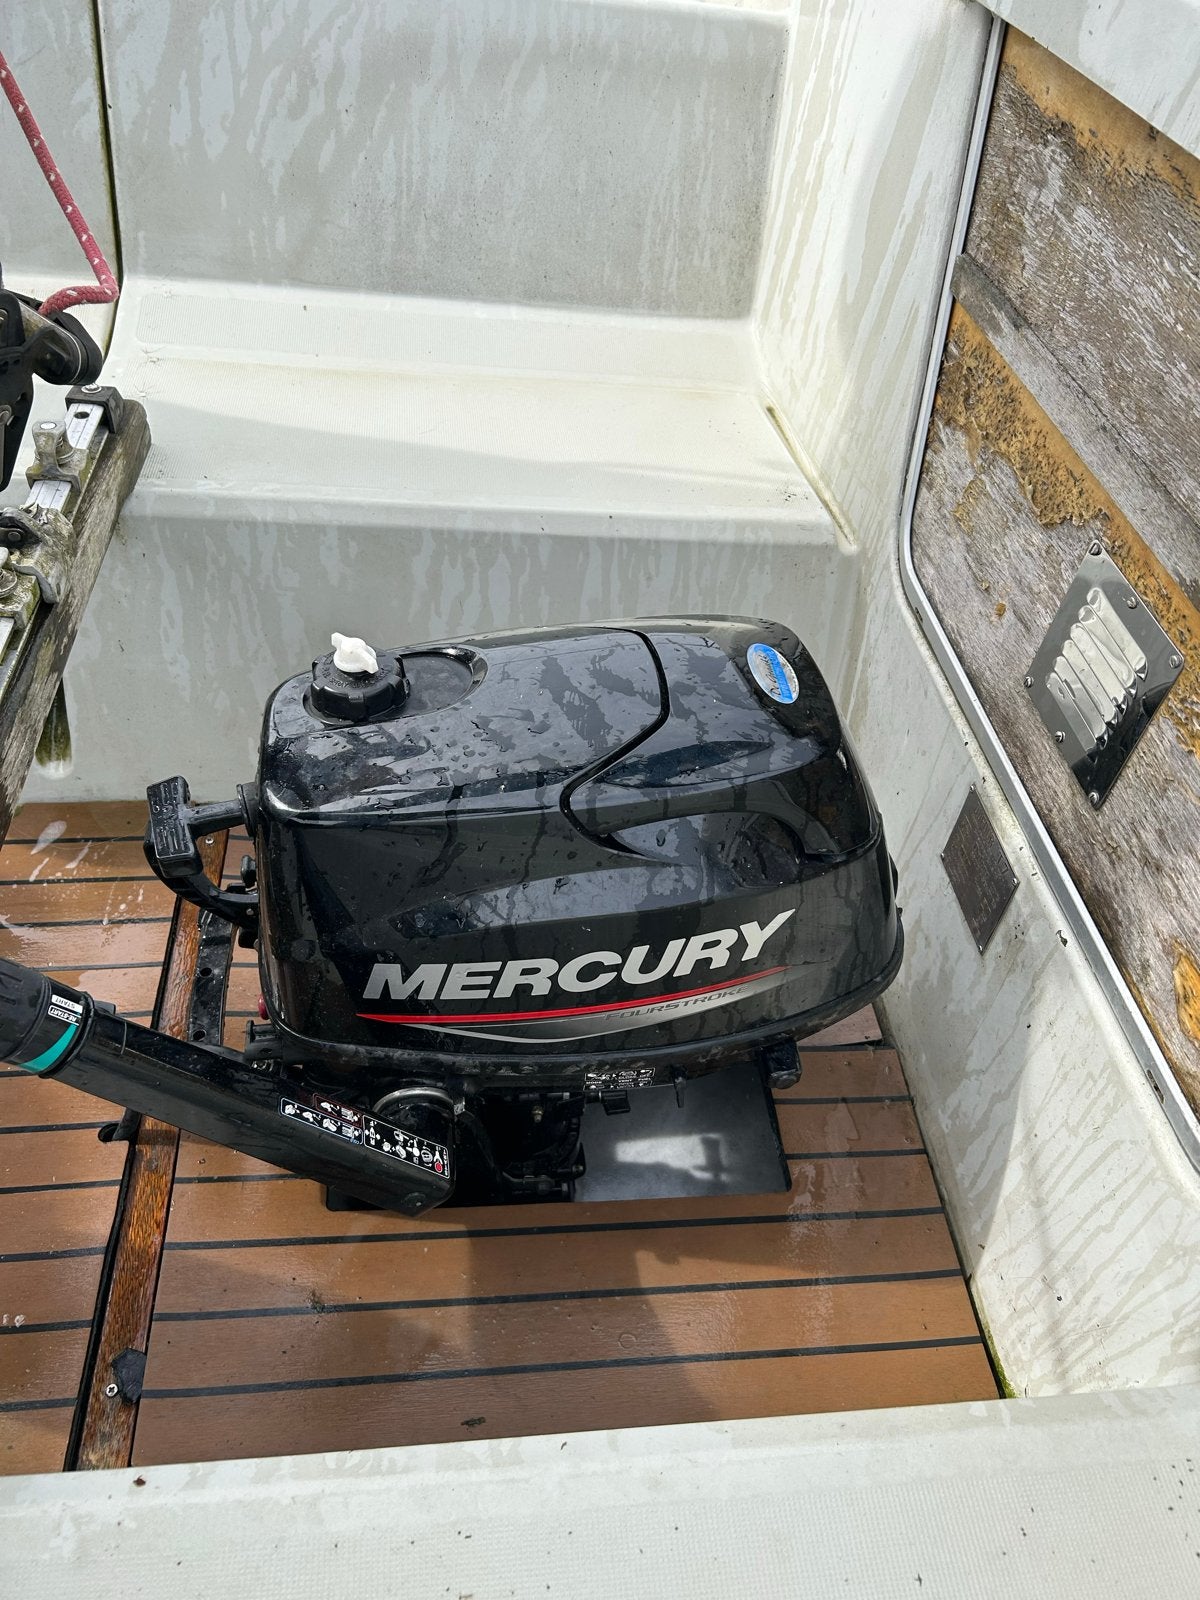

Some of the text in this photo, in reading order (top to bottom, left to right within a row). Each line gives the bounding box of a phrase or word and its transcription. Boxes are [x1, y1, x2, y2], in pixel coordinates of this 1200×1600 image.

[362, 908, 796, 1000] MERCURY
[50, 1008, 77, 1022] RE-START
[55, 997, 76, 1009] START
[604, 985, 752, 1021] FOURSTROKE
